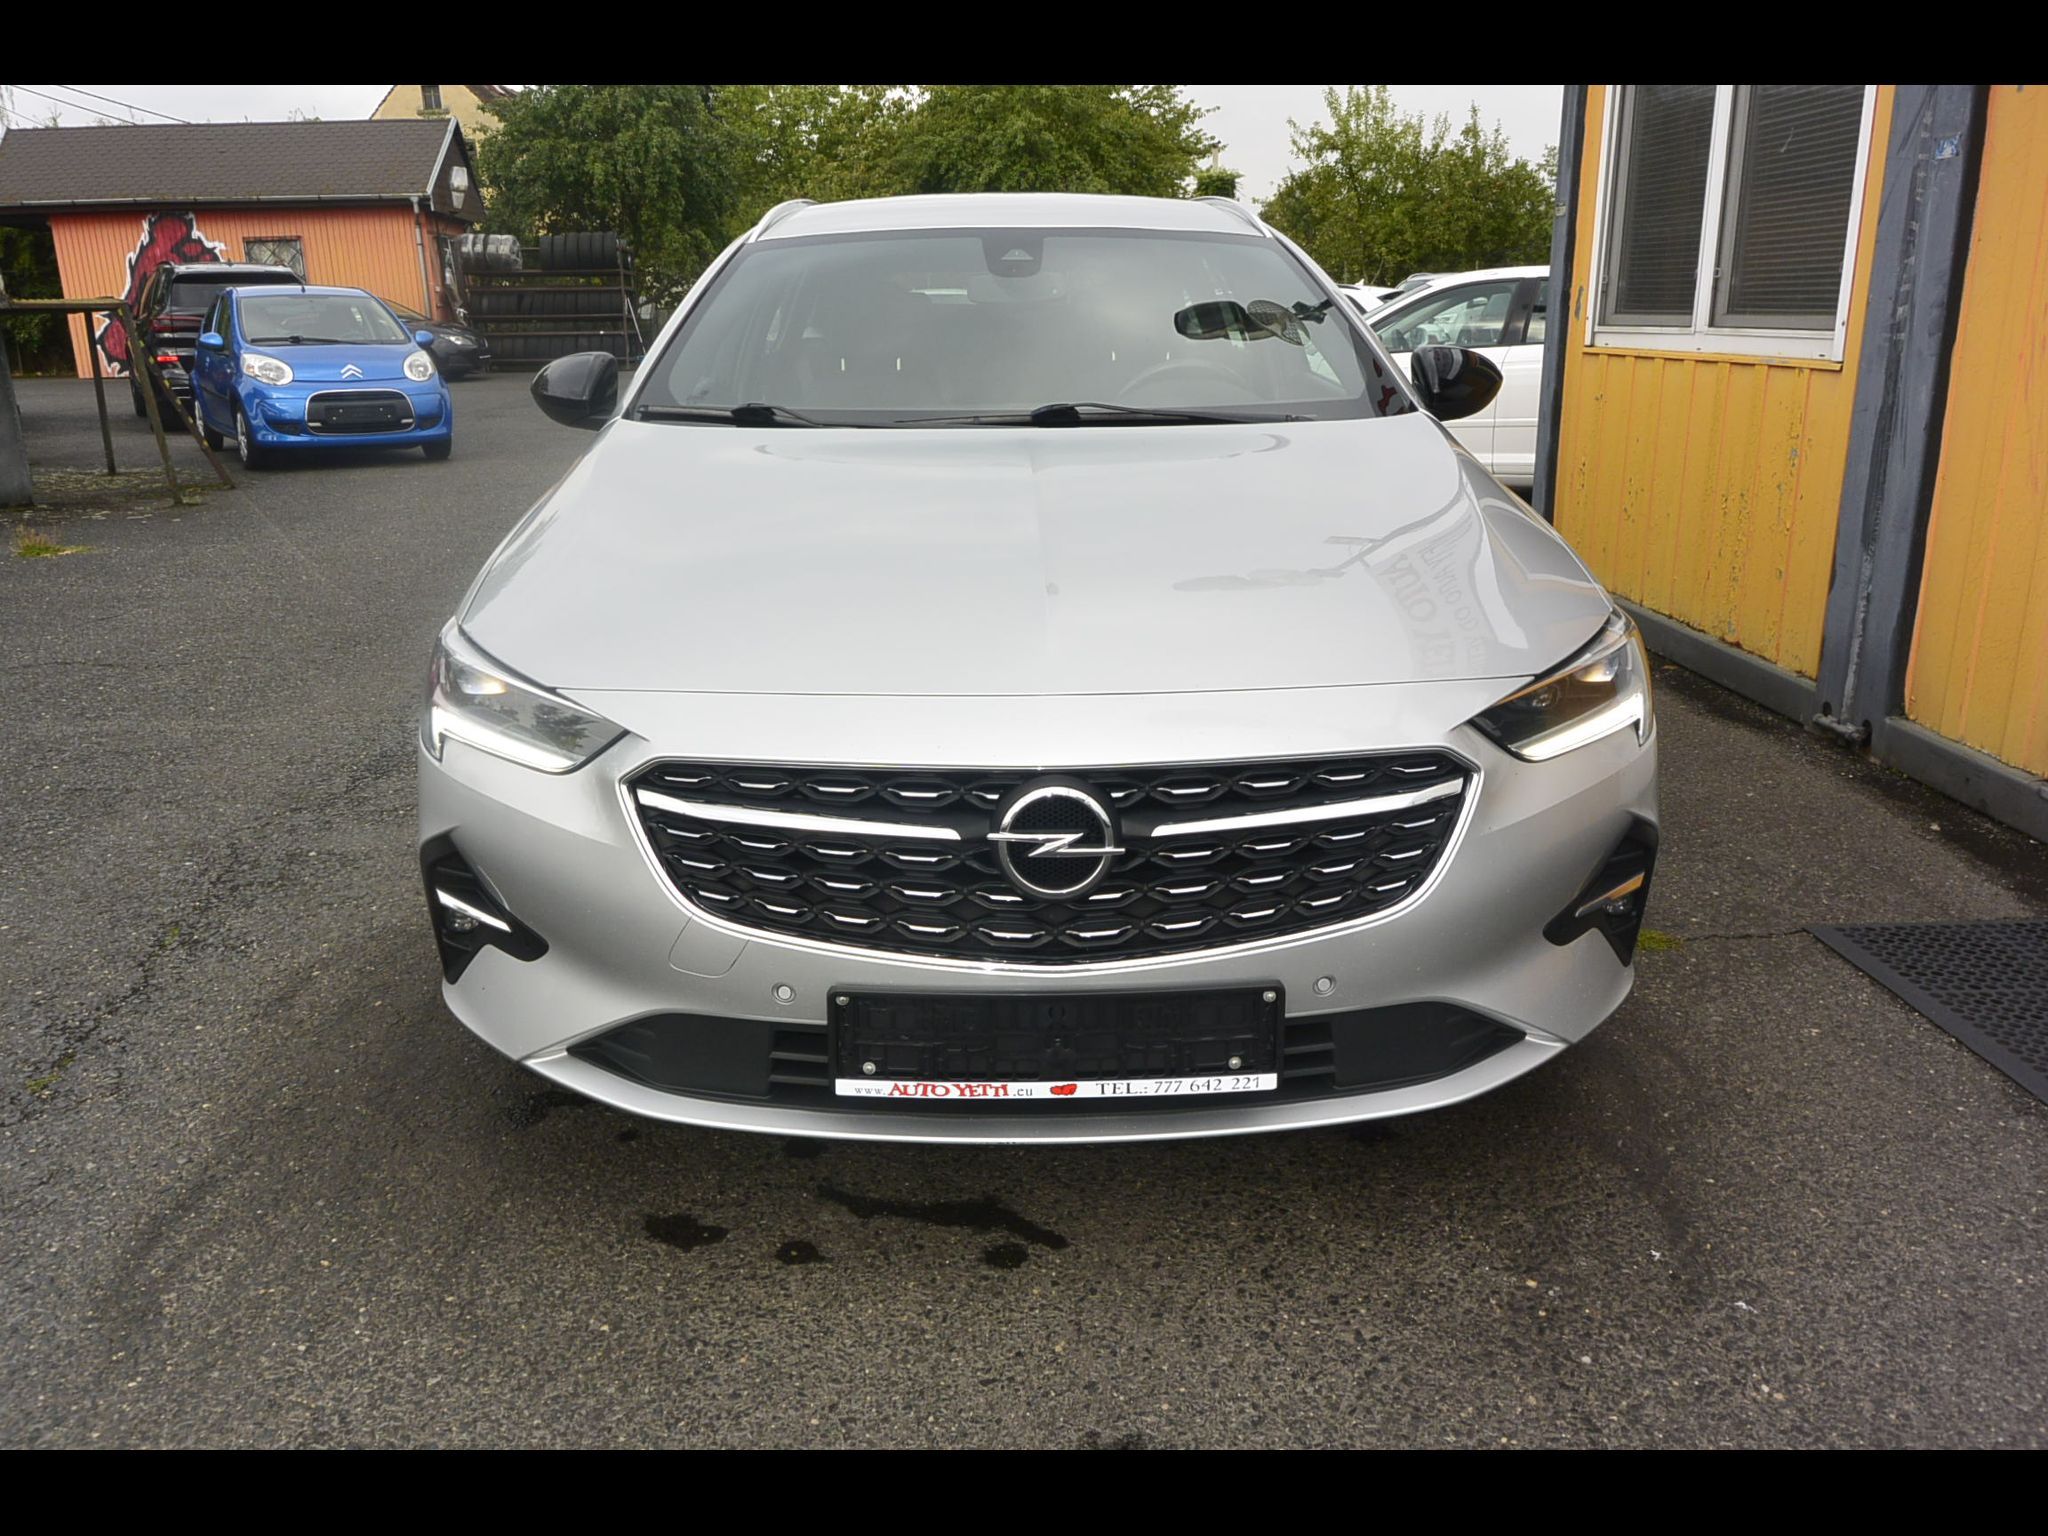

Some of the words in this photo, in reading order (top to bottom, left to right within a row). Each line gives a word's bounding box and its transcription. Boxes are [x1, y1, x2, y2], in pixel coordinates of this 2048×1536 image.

[1095, 1082, 1148, 1095] TEL.:
[1154, 1080, 1183, 1094] 777
[1189, 1078, 1223, 1092] 642
[1231, 1076, 1260, 1090] 221
